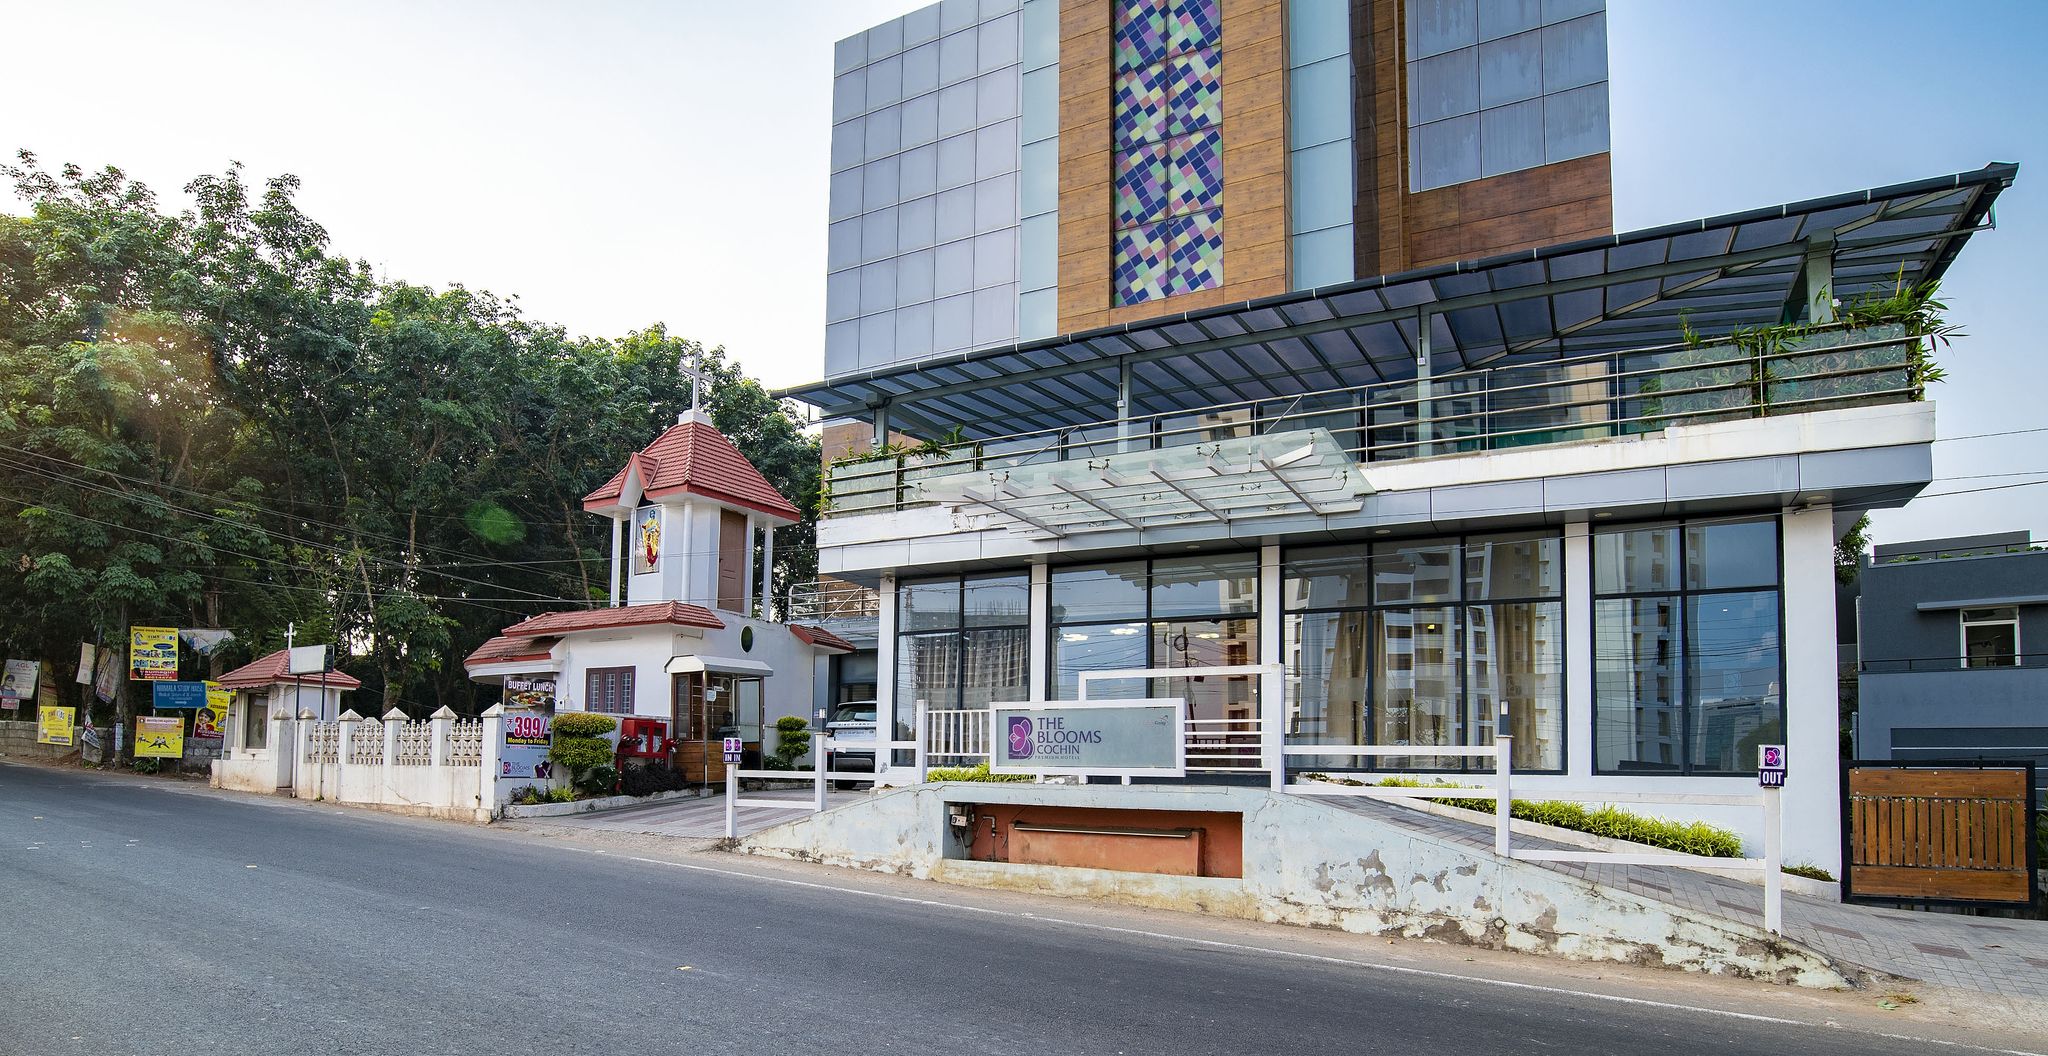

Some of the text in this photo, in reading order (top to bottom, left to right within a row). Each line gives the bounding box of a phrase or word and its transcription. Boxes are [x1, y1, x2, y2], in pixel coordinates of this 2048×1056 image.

[177, 684, 190, 692] STUDY
[508, 680, 554, 692] BUFFET LUNCH
[1037, 717, 1065, 730] THE
[507, 737, 527, 745] Monday
[1037, 730, 1102, 744] BLOOMS
[1036, 744, 1080, 755] COCHIN
[733, 753, 741, 762] IN
[1762, 771, 1783, 784] OUT
